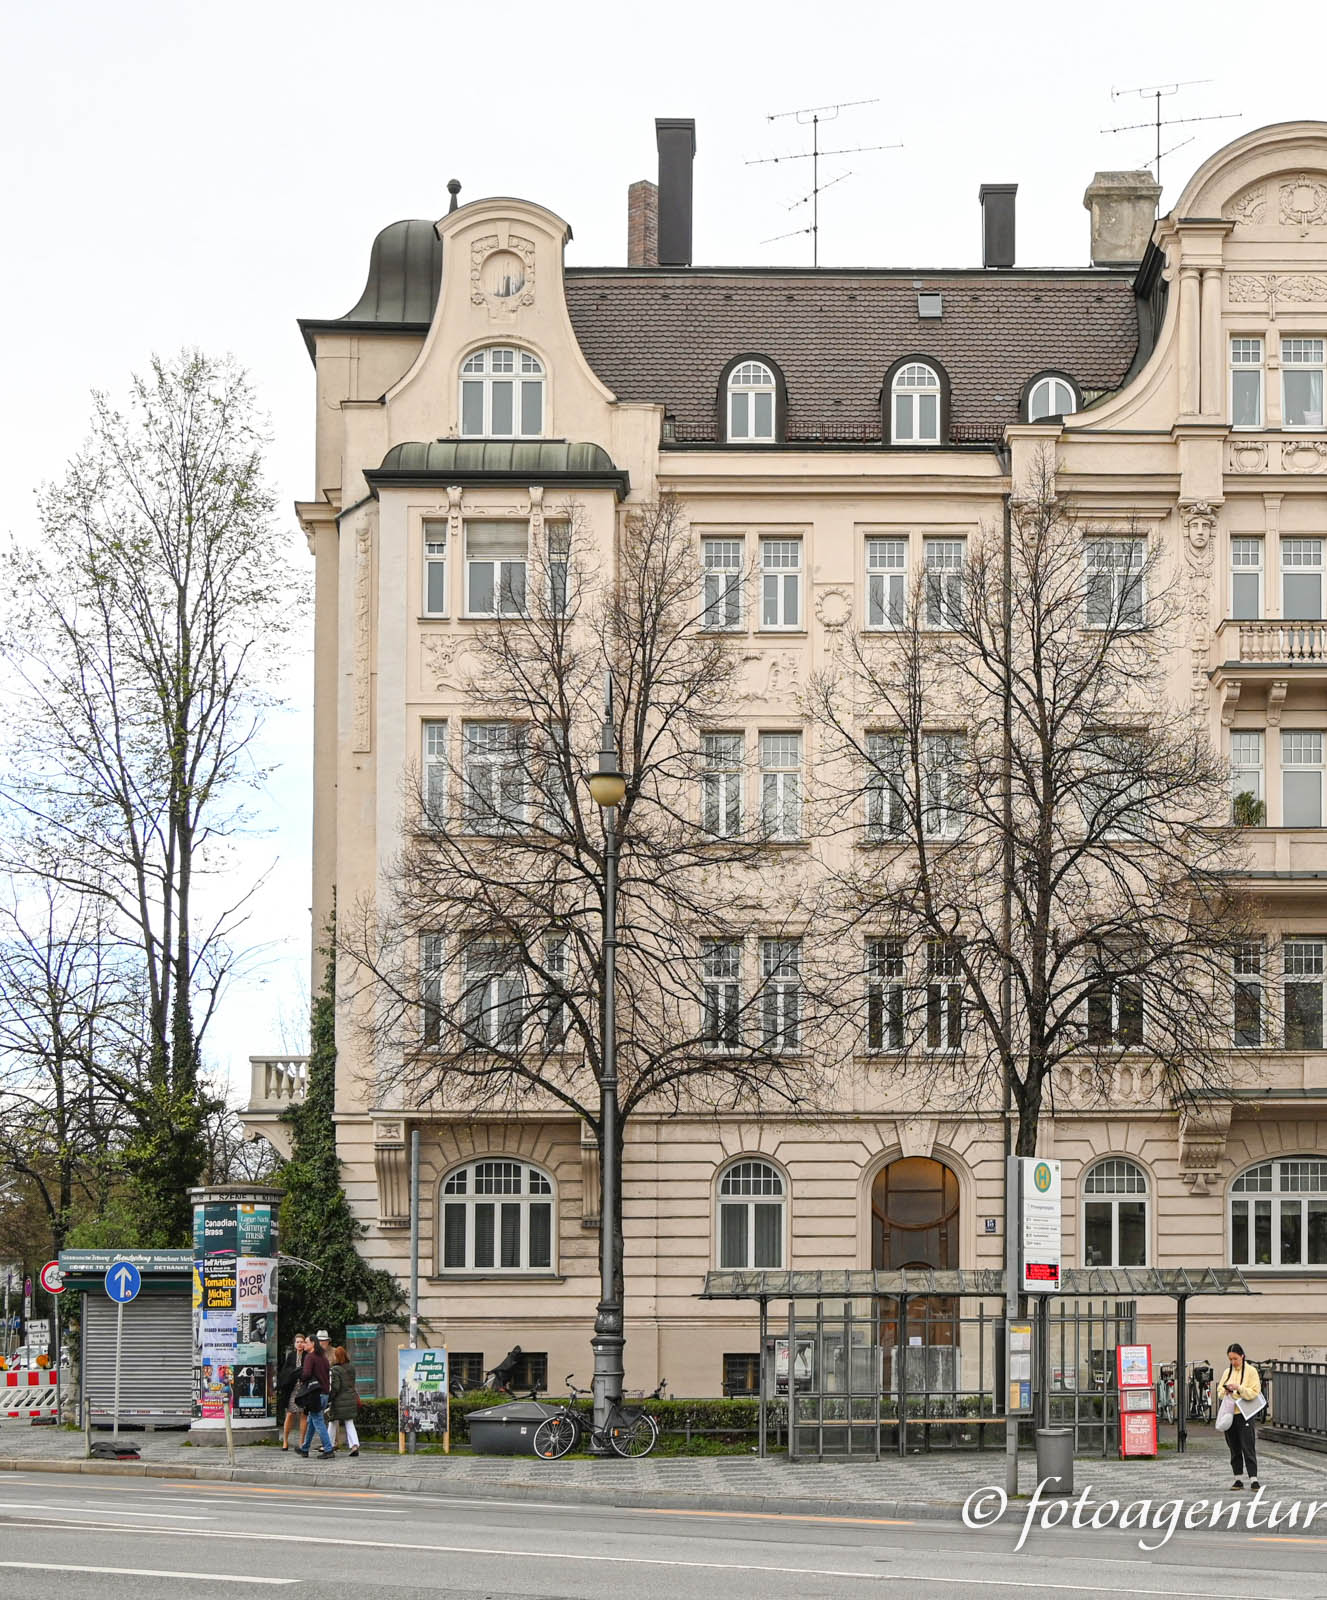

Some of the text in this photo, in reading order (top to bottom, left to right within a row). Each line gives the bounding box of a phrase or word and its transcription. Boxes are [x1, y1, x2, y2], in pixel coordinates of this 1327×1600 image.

[204, 1218, 237, 1228] Canadian
[238, 1222, 267, 1232] Kammer
[204, 1228, 224, 1236] Brass
[245, 1231, 265, 1240] musik
[204, 1277, 236, 1287] Tomatito
[240, 1272, 267, 1287] MOBY
[208, 1289, 231, 1298] Michel
[240, 1284, 264, 1298] DICK
[207, 1298, 232, 1307] Camilo
